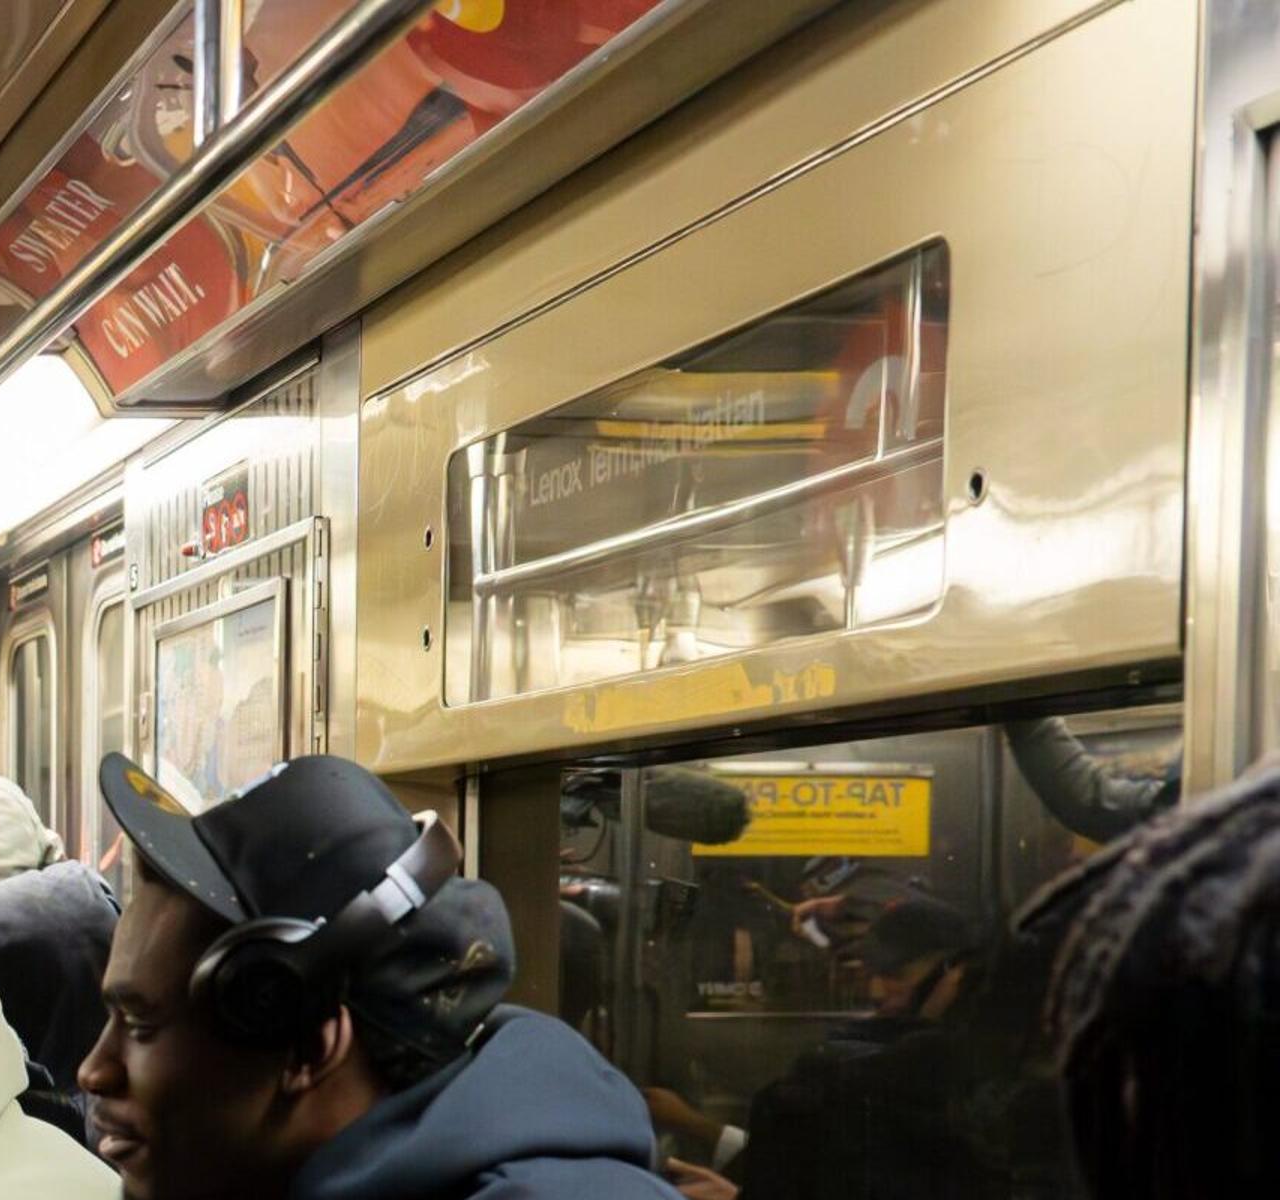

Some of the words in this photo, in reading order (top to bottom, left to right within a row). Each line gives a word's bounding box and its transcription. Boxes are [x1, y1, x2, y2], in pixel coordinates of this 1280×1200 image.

[8, 179, 116, 273] SWEATER
[101, 301, 151, 359] CAN
[132, 262, 206, 330] WAIT.
[528, 456, 583, 507] Lenox
